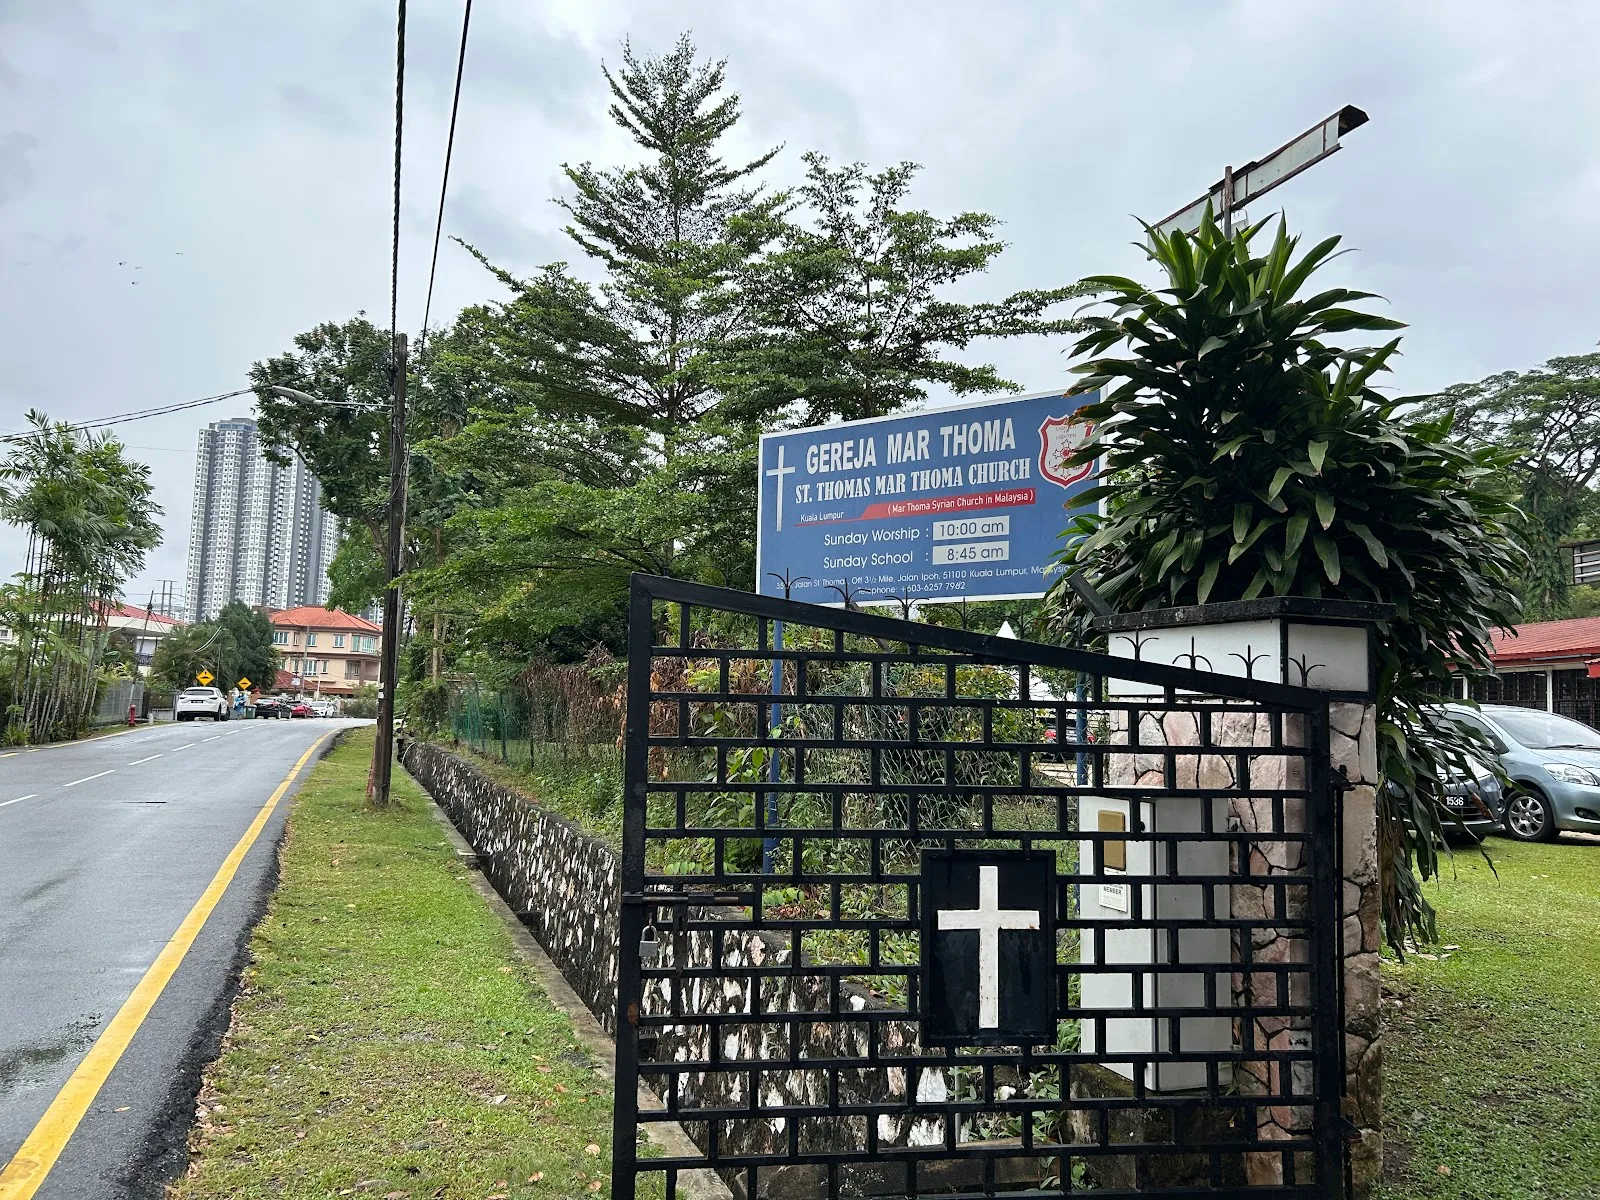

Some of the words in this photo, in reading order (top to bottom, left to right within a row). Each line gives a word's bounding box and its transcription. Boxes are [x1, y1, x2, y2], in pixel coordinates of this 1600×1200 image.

[806, 437, 876, 474] GEREJA
[887, 429, 930, 465] MAR
[940, 418, 1016, 458] THOMA
[795, 484, 812, 504] ST.
[816, 476, 870, 502] THOMAS
[875, 473, 906, 496] MAR
[910, 466, 964, 492] THOMA
[968, 458, 1030, 484] CHURCH
[892, 504, 906, 514] Mar
[906, 502, 930, 512] Thoma
[932, 499, 955, 512] Syrian
[956, 496, 984, 508] Church
[986, 496, 992, 504] in
[994, 492, 1028, 505] Malaysia
[800, 513, 818, 522] Kuala
[819, 511, 844, 522] Lumpur
[824, 531, 868, 546] Sunday
[872, 526, 920, 542] Worship
[940, 522, 978, 537] 10:00
[981, 522, 1004, 534] am
[824, 555, 868, 570] Sunday
[872, 551, 913, 566] School
[947, 546, 976, 561] 8:45
[981, 546, 1004, 558] am
[794, 580, 812, 588] Jalan
[822, 578, 850, 587] Thoma,
[852, 576, 862, 584] Off
[898, 574, 918, 582] Jalan
[921, 572, 940, 581] Ipoh,
[942, 570, 967, 579] 51100
[970, 568, 992, 578] Kuala
[996, 566, 1028, 578] Lumpur,
[1030, 564, 1070, 575] Maysia
[1446, 796, 1464, 806] 1536
